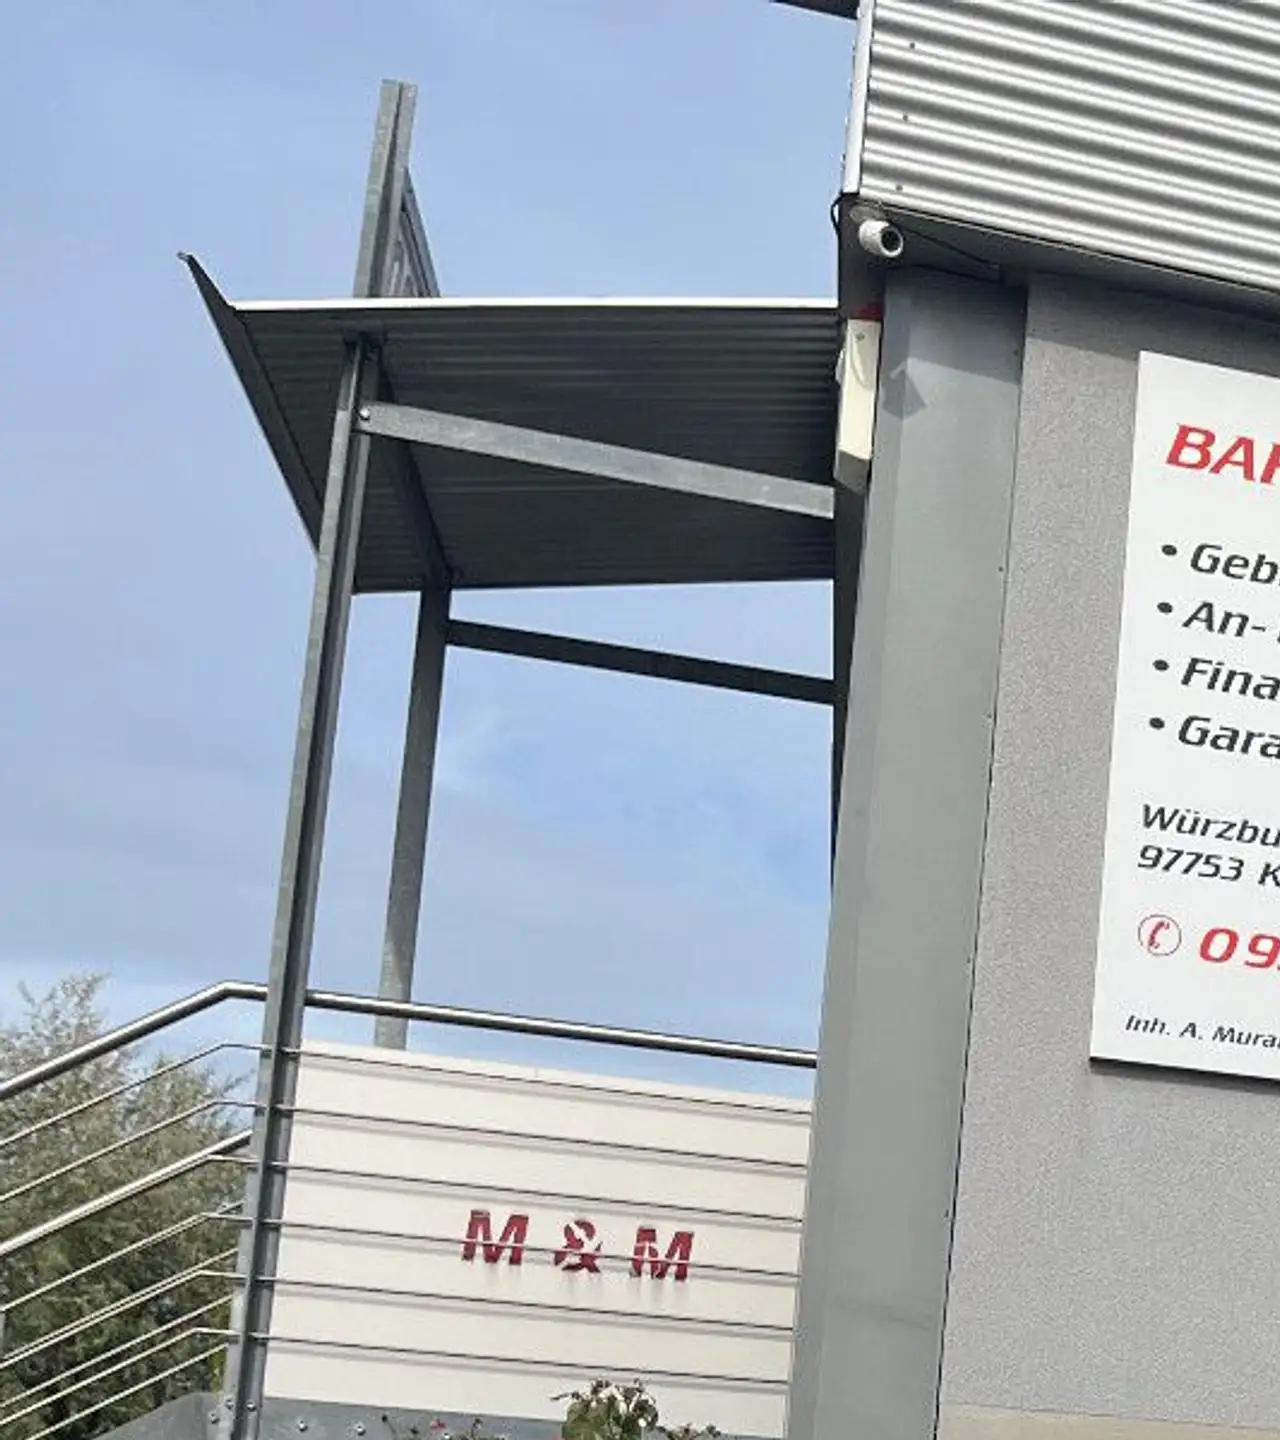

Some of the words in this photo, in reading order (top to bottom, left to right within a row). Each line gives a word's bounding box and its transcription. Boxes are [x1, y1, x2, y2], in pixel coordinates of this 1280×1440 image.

[1182, 601, 1267, 638] An-
[1137, 844, 1245, 882] 97753
[1125, 1014, 1171, 1037] Inh.
[1179, 1021, 1204, 1041] A.
[461, 1208, 529, 1266] M
[630, 1226, 694, 1282] M
